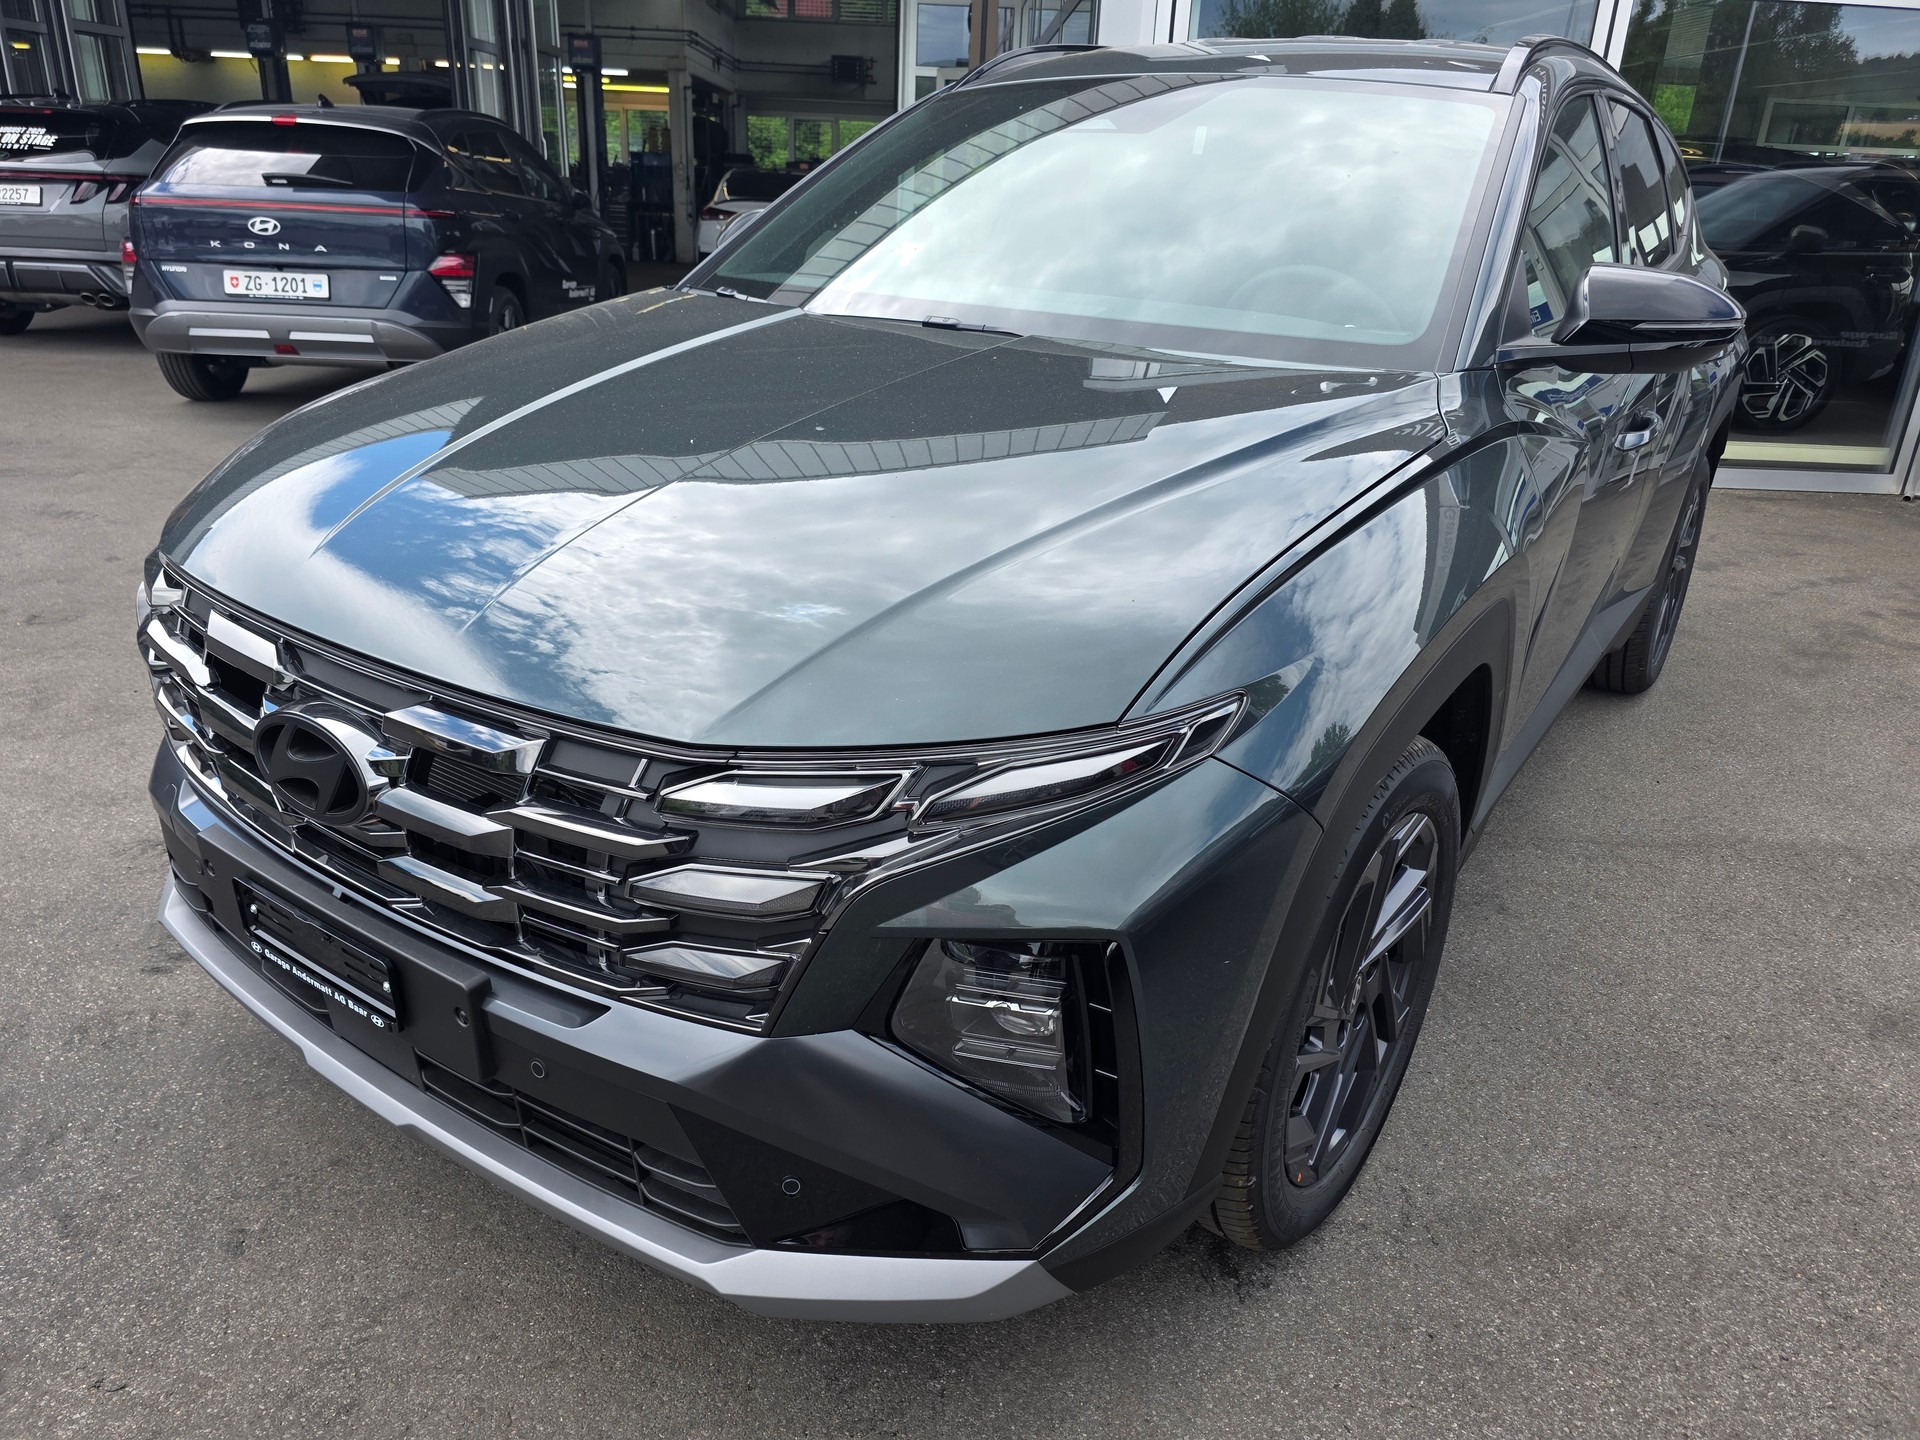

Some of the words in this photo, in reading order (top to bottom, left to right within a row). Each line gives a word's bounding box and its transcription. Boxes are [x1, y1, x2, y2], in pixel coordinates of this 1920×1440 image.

[1, 133, 20, 144] ON
[19, 133, 59, 147] STAGE
[0, 188, 29, 200] 2257
[210, 240, 328, 252] KONA
[264, 948, 291, 971] Garage
[292, 965, 333, 996] Andermatt
[334, 991, 346, 1006] AG
[348, 999, 368, 1018] Baar
